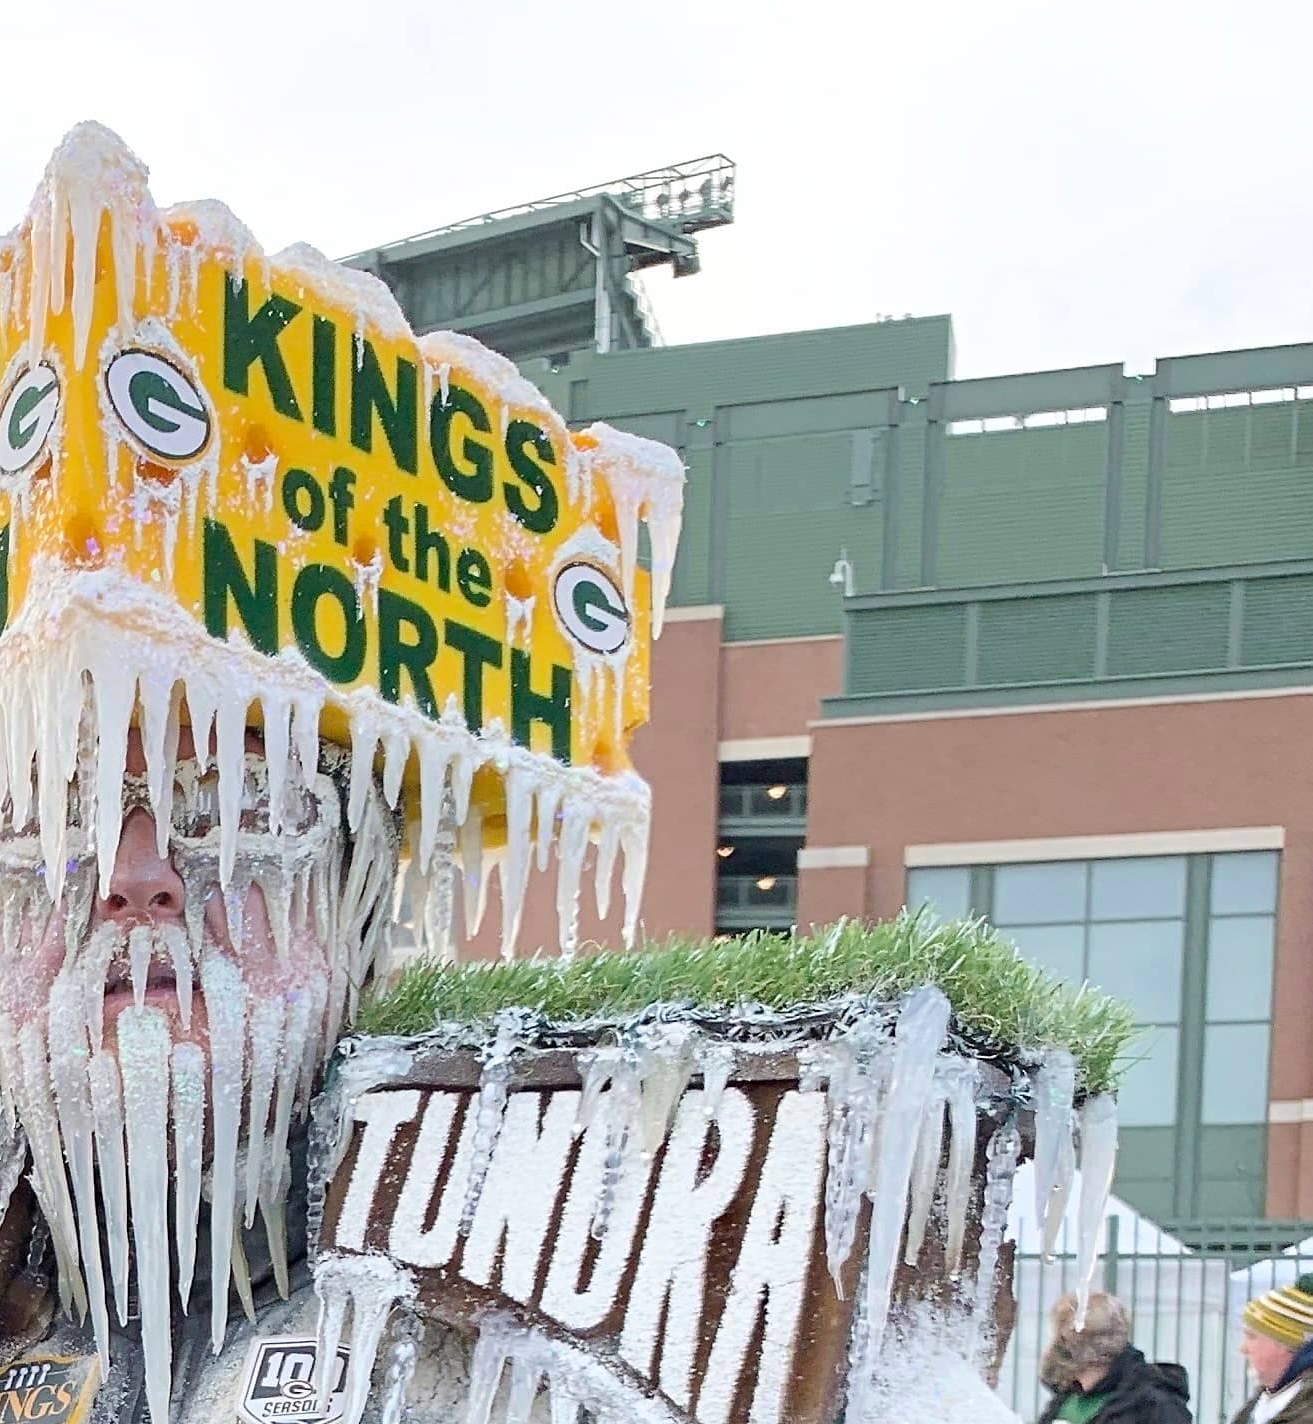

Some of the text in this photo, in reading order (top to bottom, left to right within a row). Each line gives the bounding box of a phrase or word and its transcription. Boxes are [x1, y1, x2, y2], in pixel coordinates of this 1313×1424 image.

[222, 270, 562, 535] KINGS
[281, 468, 494, 607] of the
[203, 520, 575, 764] NORTH
[262, 1399, 333, 1418] SEASO
